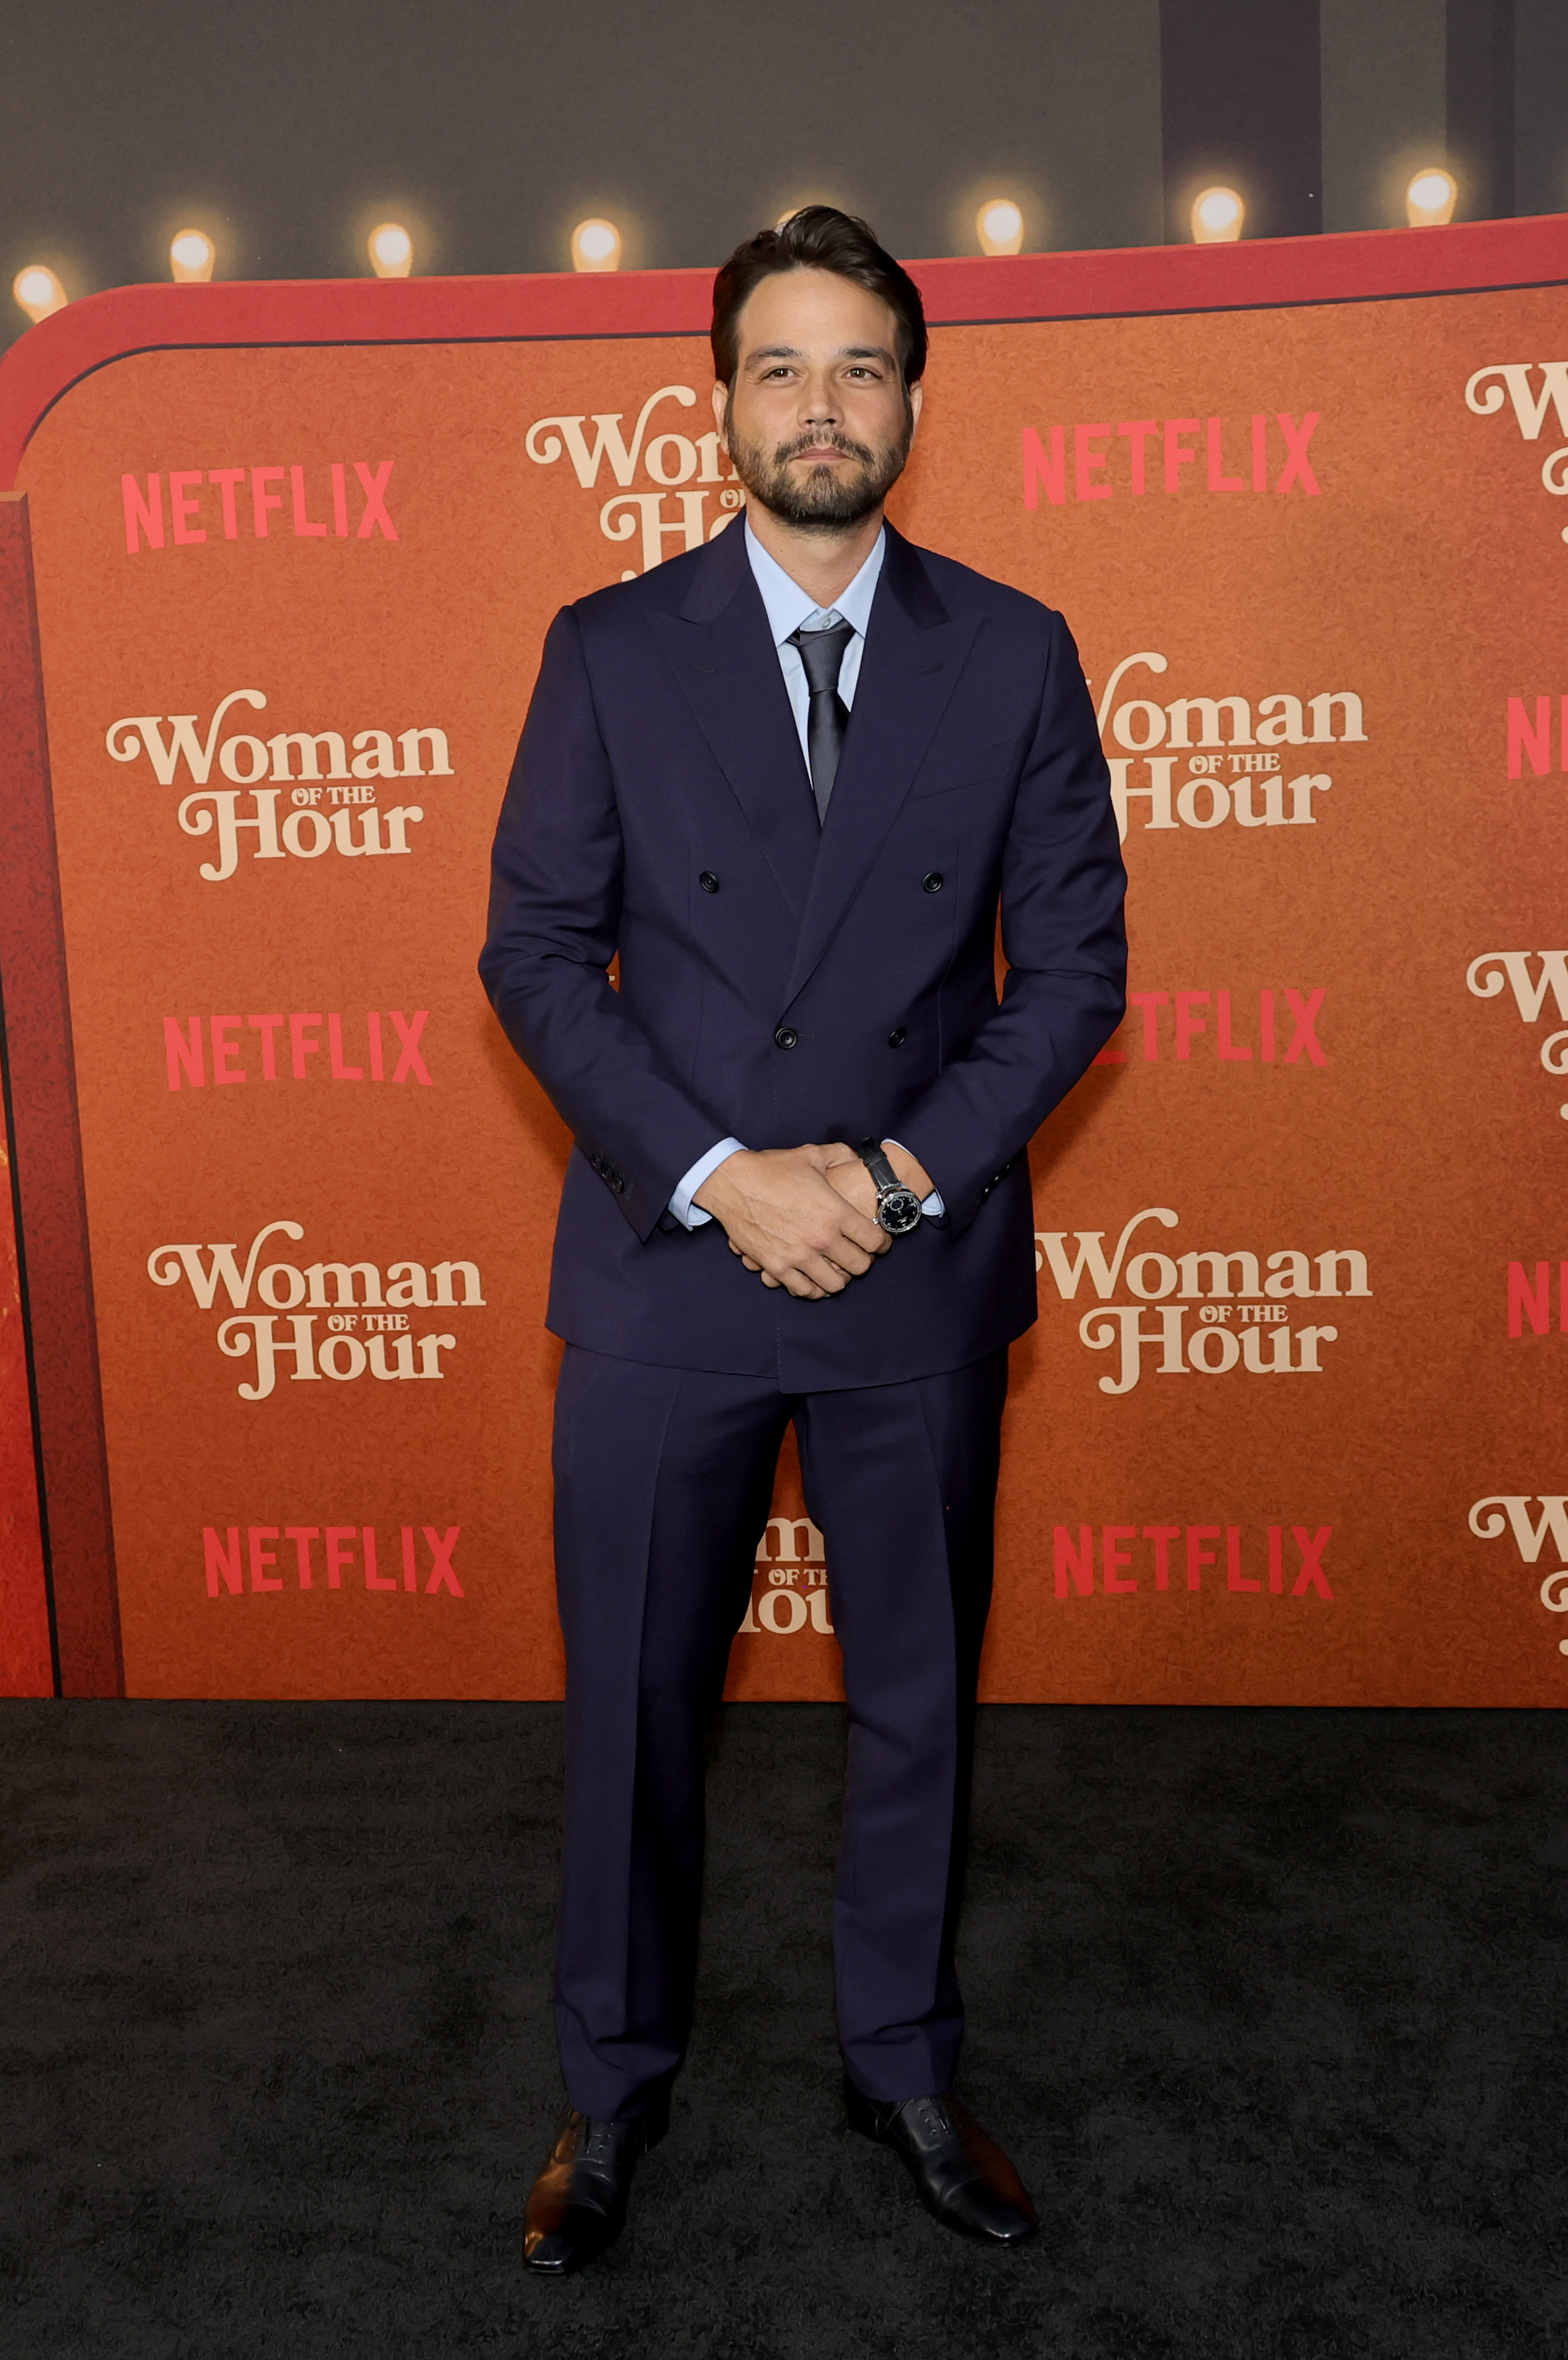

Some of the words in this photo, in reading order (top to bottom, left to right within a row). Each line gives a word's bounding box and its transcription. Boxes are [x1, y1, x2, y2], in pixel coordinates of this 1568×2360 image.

[1022, 411, 1321, 511] NETFLIX
[121, 460, 400, 554] NETFLIX
[106, 688, 455, 786] Woman
[1188, 754, 1224, 775] OF
[1227, 751, 1282, 773] THE
[177, 788, 424, 882] Hour
[290, 787, 324, 807] OF
[326, 785, 376, 805] THE
[1106, 756, 1333, 846] Hour
[163, 1010, 434, 1092] NETFLIX
[1091, 987, 1327, 1067] TFLIX
[147, 1220, 487, 1309] Woman
[1034, 1207, 1373, 1300] Woman
[327, 1313, 358, 1332] OF
[361, 1313, 410, 1332] THE
[1079, 1305, 1338, 1395] Hour
[1199, 1304, 1233, 1324] OF
[1236, 1304, 1289, 1323] THE
[217, 1314, 456, 1401] Hour
[202, 1526, 464, 1598] NETFLIX
[768, 1568, 800, 1586] OF
[1053, 1525, 1335, 1600] NETFLIX
